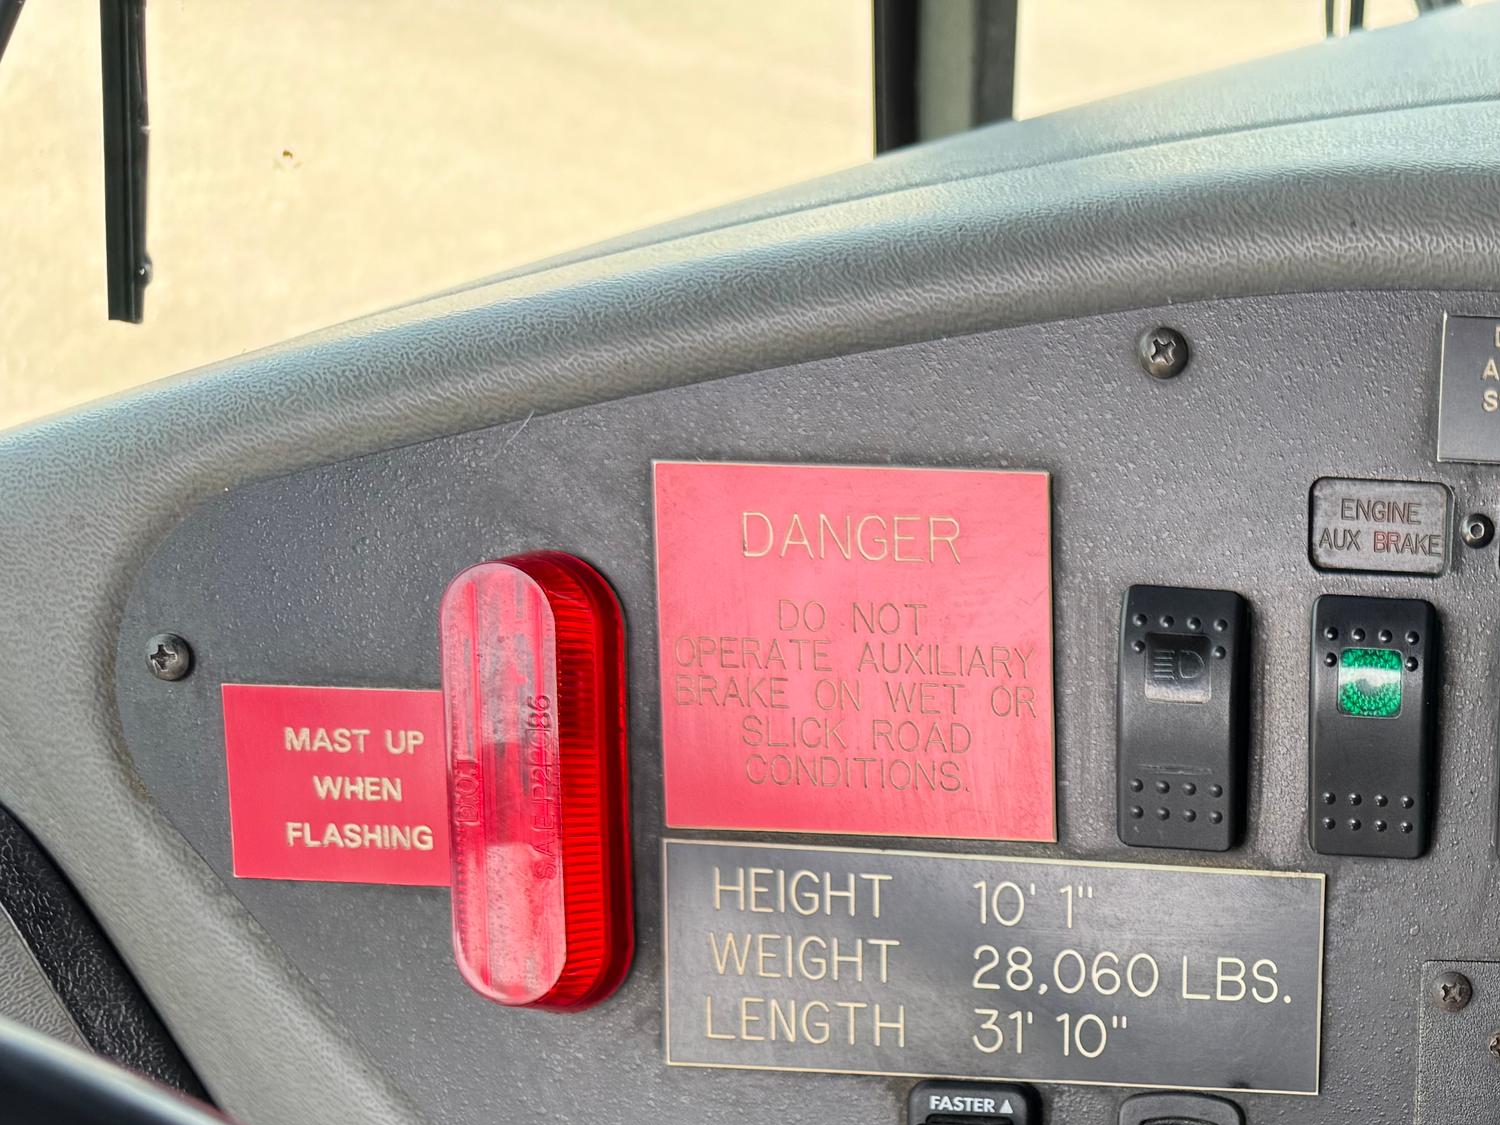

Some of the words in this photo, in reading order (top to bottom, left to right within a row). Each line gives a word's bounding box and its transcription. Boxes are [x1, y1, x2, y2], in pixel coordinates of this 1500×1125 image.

[1340, 498, 1422, 524] ENGINE
[742, 511, 961, 565] DANGER
[1318, 528, 1362, 552] AUX
[1373, 530, 1442, 556] BRAKE
[778, 599, 826, 633] DO
[853, 602, 928, 636] NOT
[673, 636, 833, 672] OPERATE
[857, 642, 1035, 679] AUXILIARY
[674, 674, 791, 710] BRAKE
[815, 679, 861, 712] ON
[885, 682, 966, 715] WET
[990, 685, 1037, 719] OR
[284, 727, 369, 752] MAST
[385, 730, 424, 755] UP
[741, 715, 847, 749] SLICK
[872, 720, 972, 754] ROAD
[313, 776, 402, 801] WHEN
[745, 754, 970, 793] CONDITIONS.
[286, 822, 434, 851] FLASHING
[713, 866, 893, 919] HEIGHT
[972, 880, 1036, 927] 10'
[708, 932, 900, 983] WEIGHT
[972, 945, 1159, 998] 28,060
[1181, 956, 1292, 1004] LBS.
[705, 997, 905, 1048] LENGTH
[972, 1008, 1034, 1053] 31'
[930, 1095, 995, 1112] FASTER
